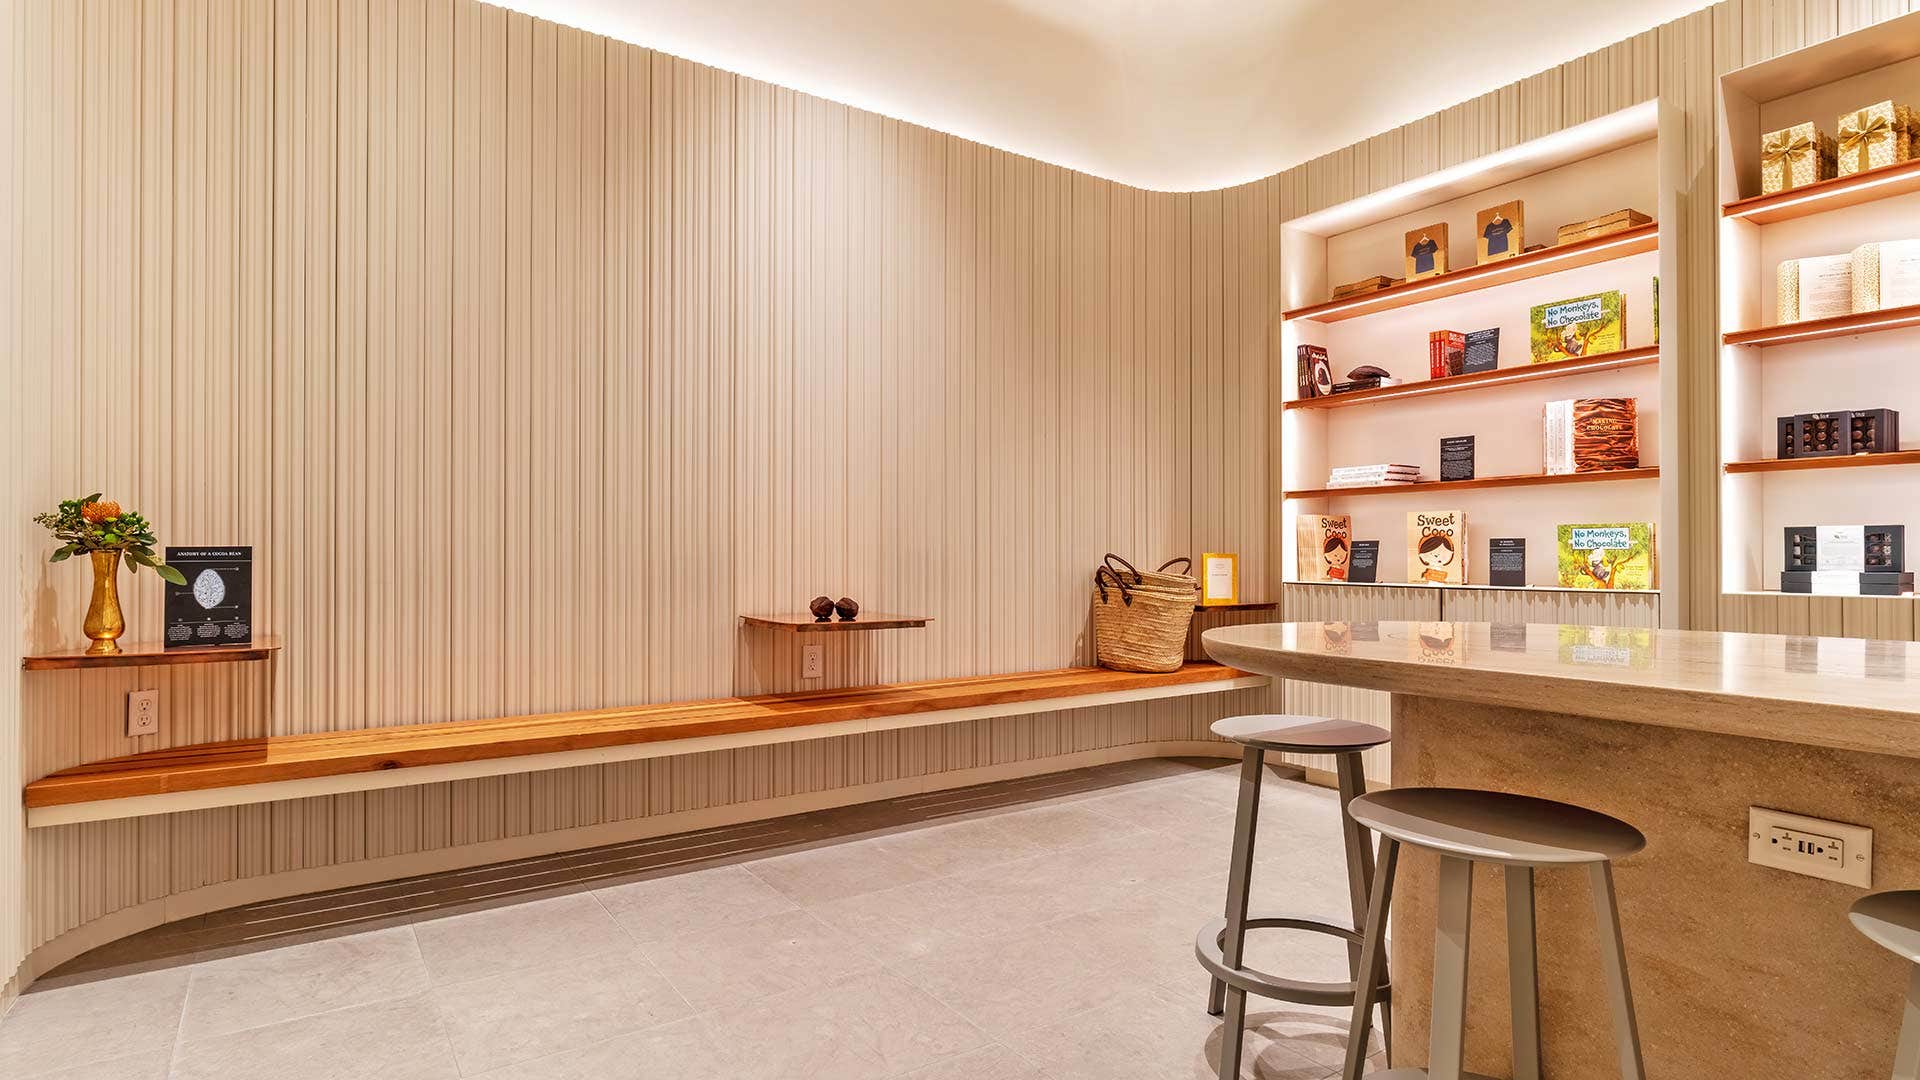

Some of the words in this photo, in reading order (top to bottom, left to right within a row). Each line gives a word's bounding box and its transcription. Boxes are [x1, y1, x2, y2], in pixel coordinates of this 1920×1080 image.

[1547, 308, 1558, 317] No
[1547, 318, 1558, 326] No
[1560, 311, 1600, 325] Chocolate
[1321, 517, 1347, 529] Sweet
[1417, 513, 1455, 526] Sweet
[1325, 528, 1347, 539] Coco
[1422, 526, 1454, 537] Coco
[1574, 530, 1585, 538] No
[1586, 530, 1627, 539] Monkeys,
[1574, 540, 1585, 548] No
[1586, 539, 1627, 549] Chocolate
